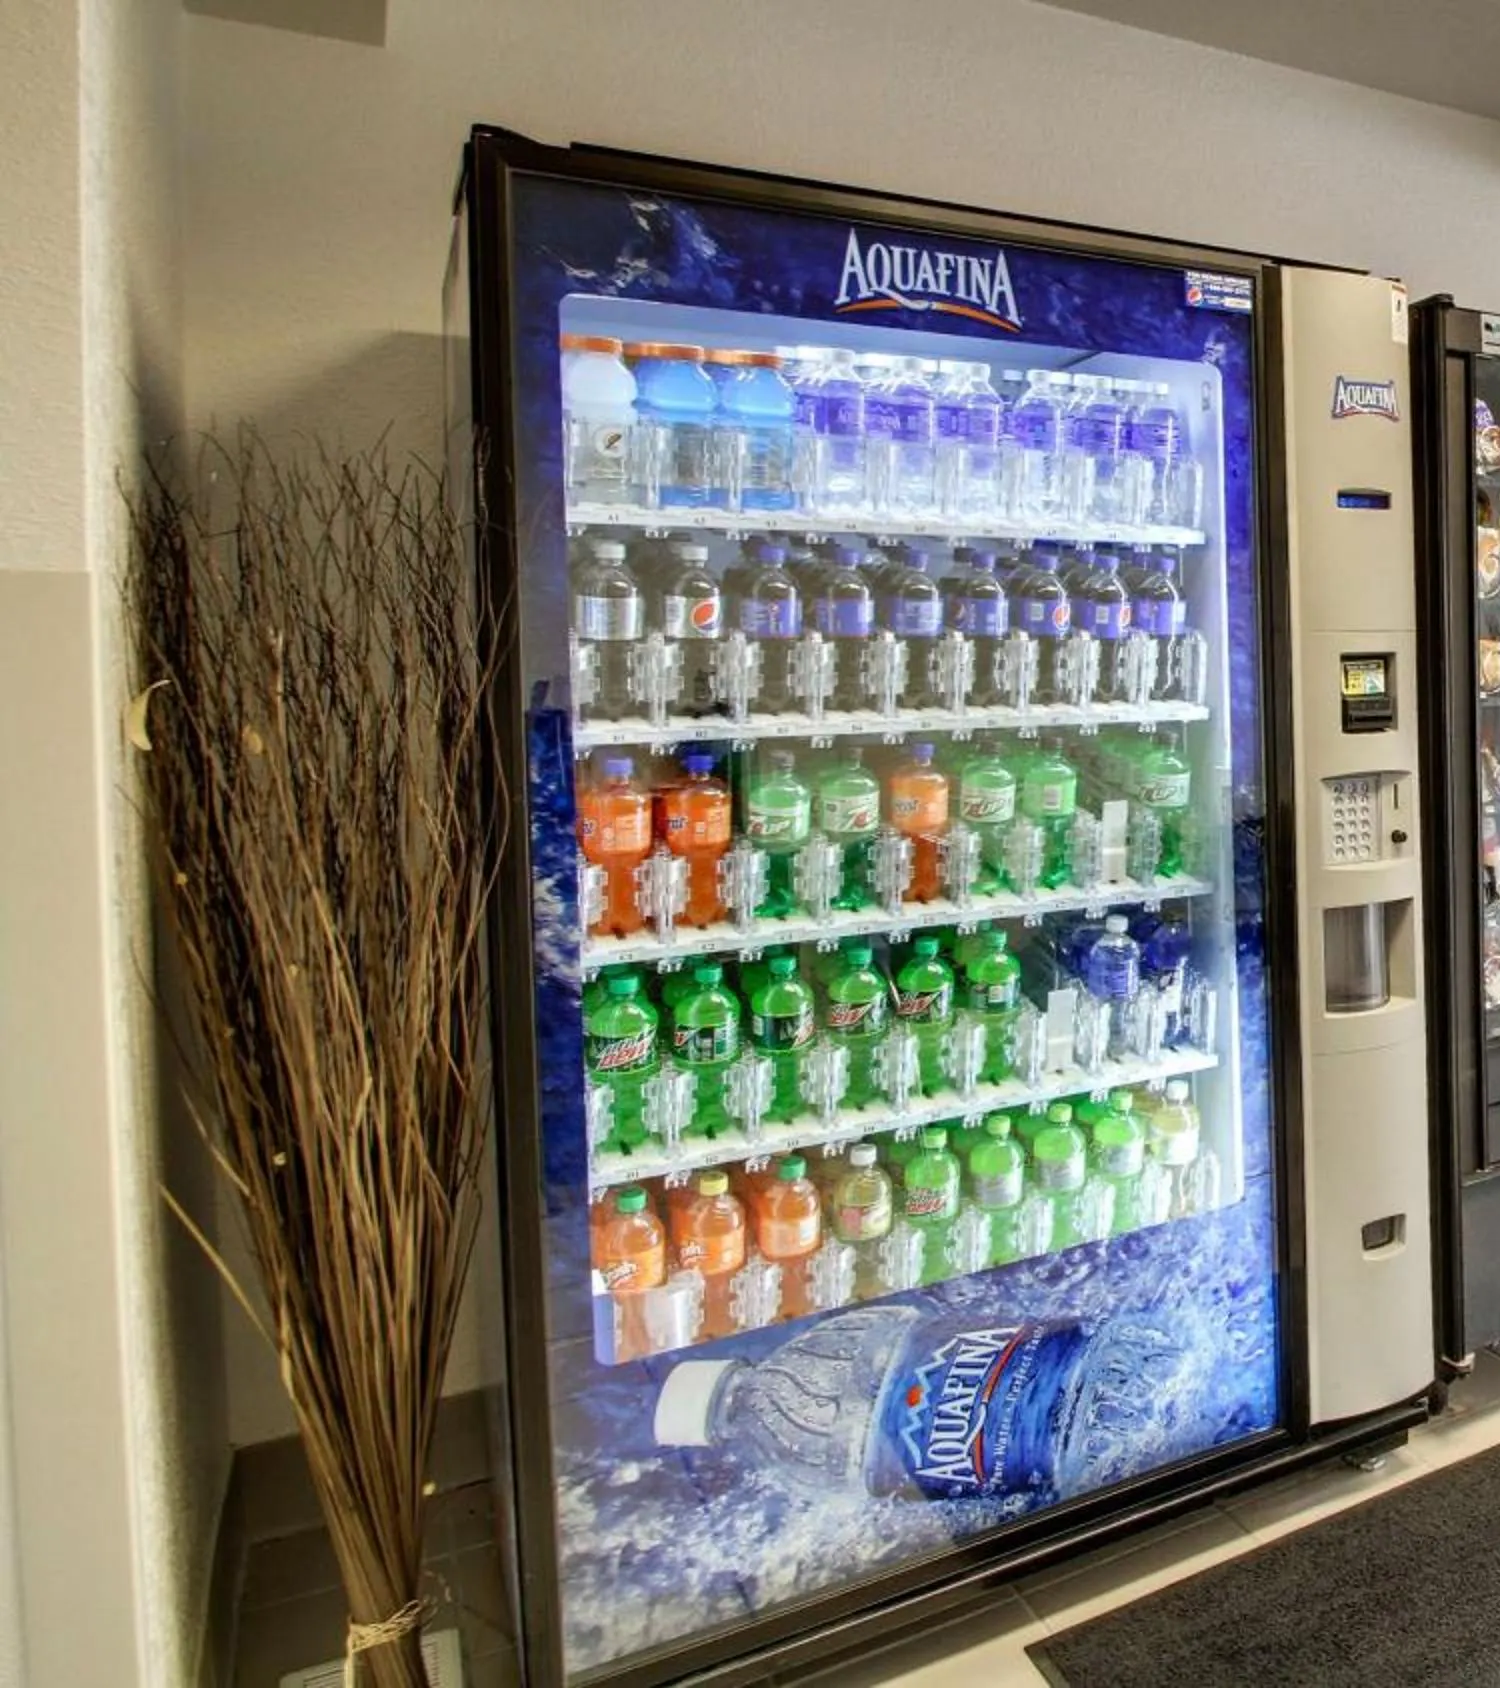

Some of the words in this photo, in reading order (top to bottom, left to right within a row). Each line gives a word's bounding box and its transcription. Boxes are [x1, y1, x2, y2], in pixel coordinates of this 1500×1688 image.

[834, 227, 1022, 325] AQUAFINA
[1334, 378, 1398, 417] AQUAFINA
[915, 1324, 1023, 1486] AQUAFINA
